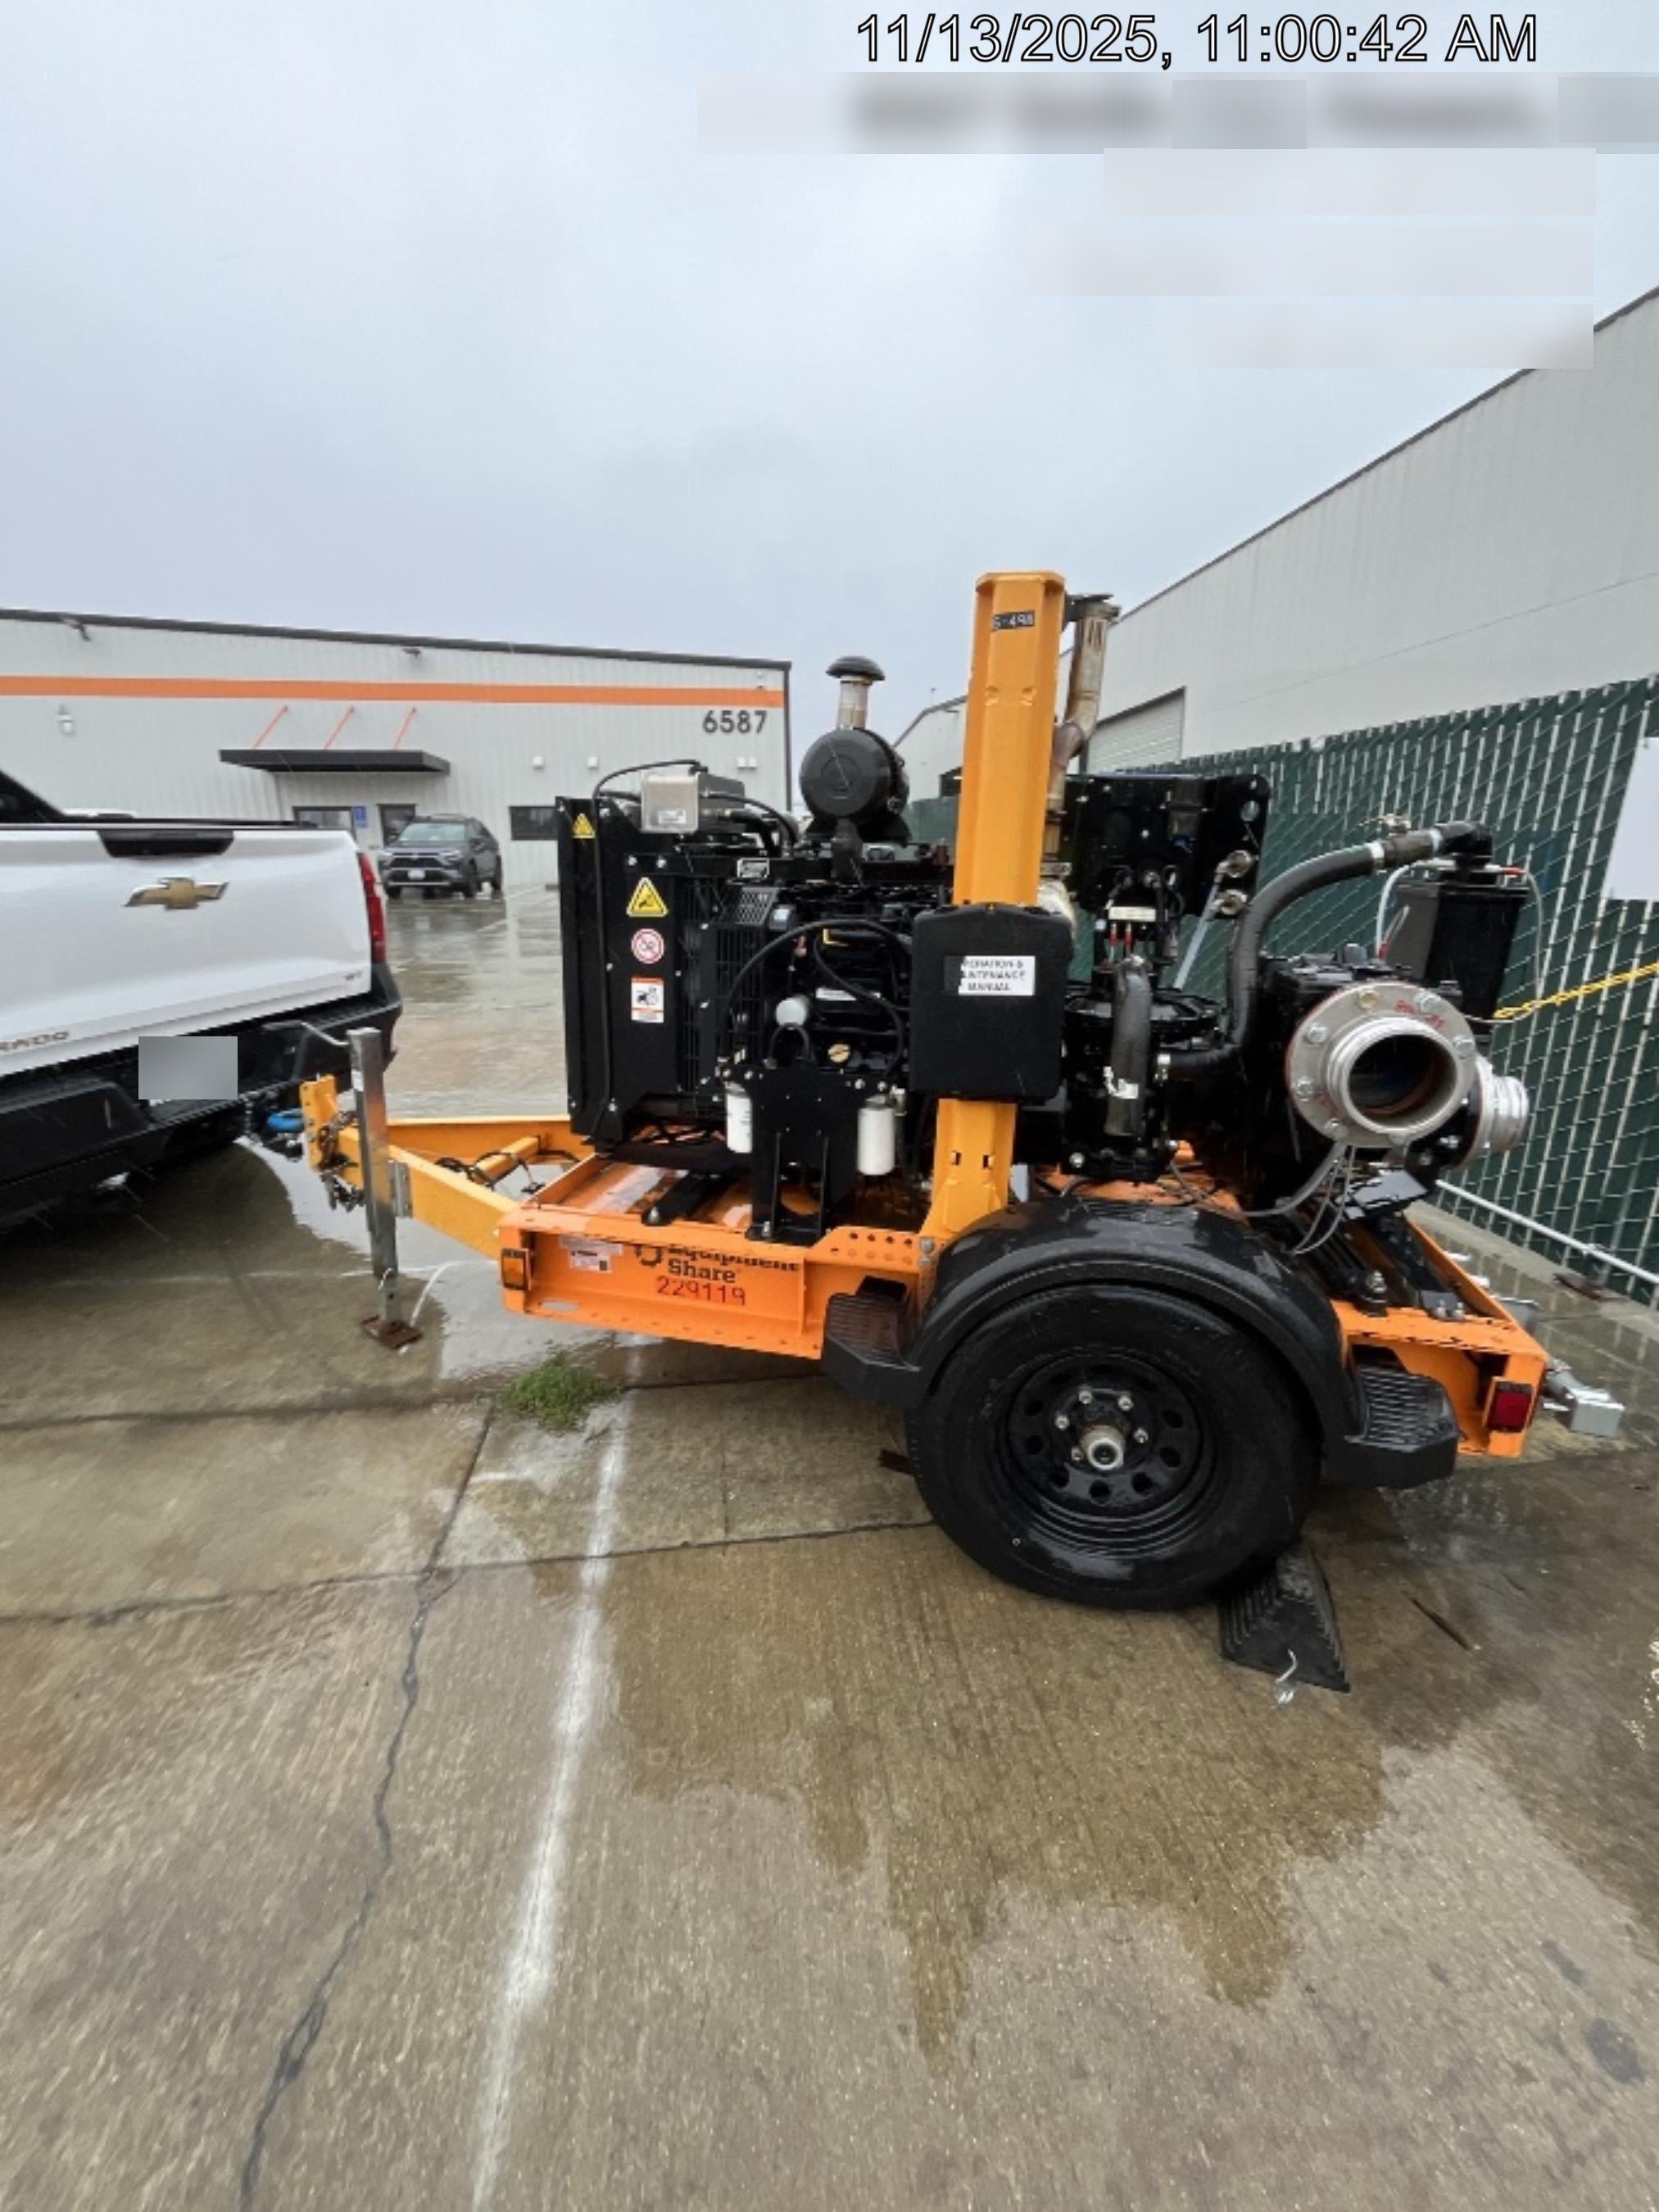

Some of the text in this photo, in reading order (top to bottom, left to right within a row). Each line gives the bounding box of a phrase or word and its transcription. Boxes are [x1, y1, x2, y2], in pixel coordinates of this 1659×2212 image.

[703, 709, 767, 733] 6587
[668, 1258, 737, 1283] Share
[657, 1276, 746, 1306] 229119
